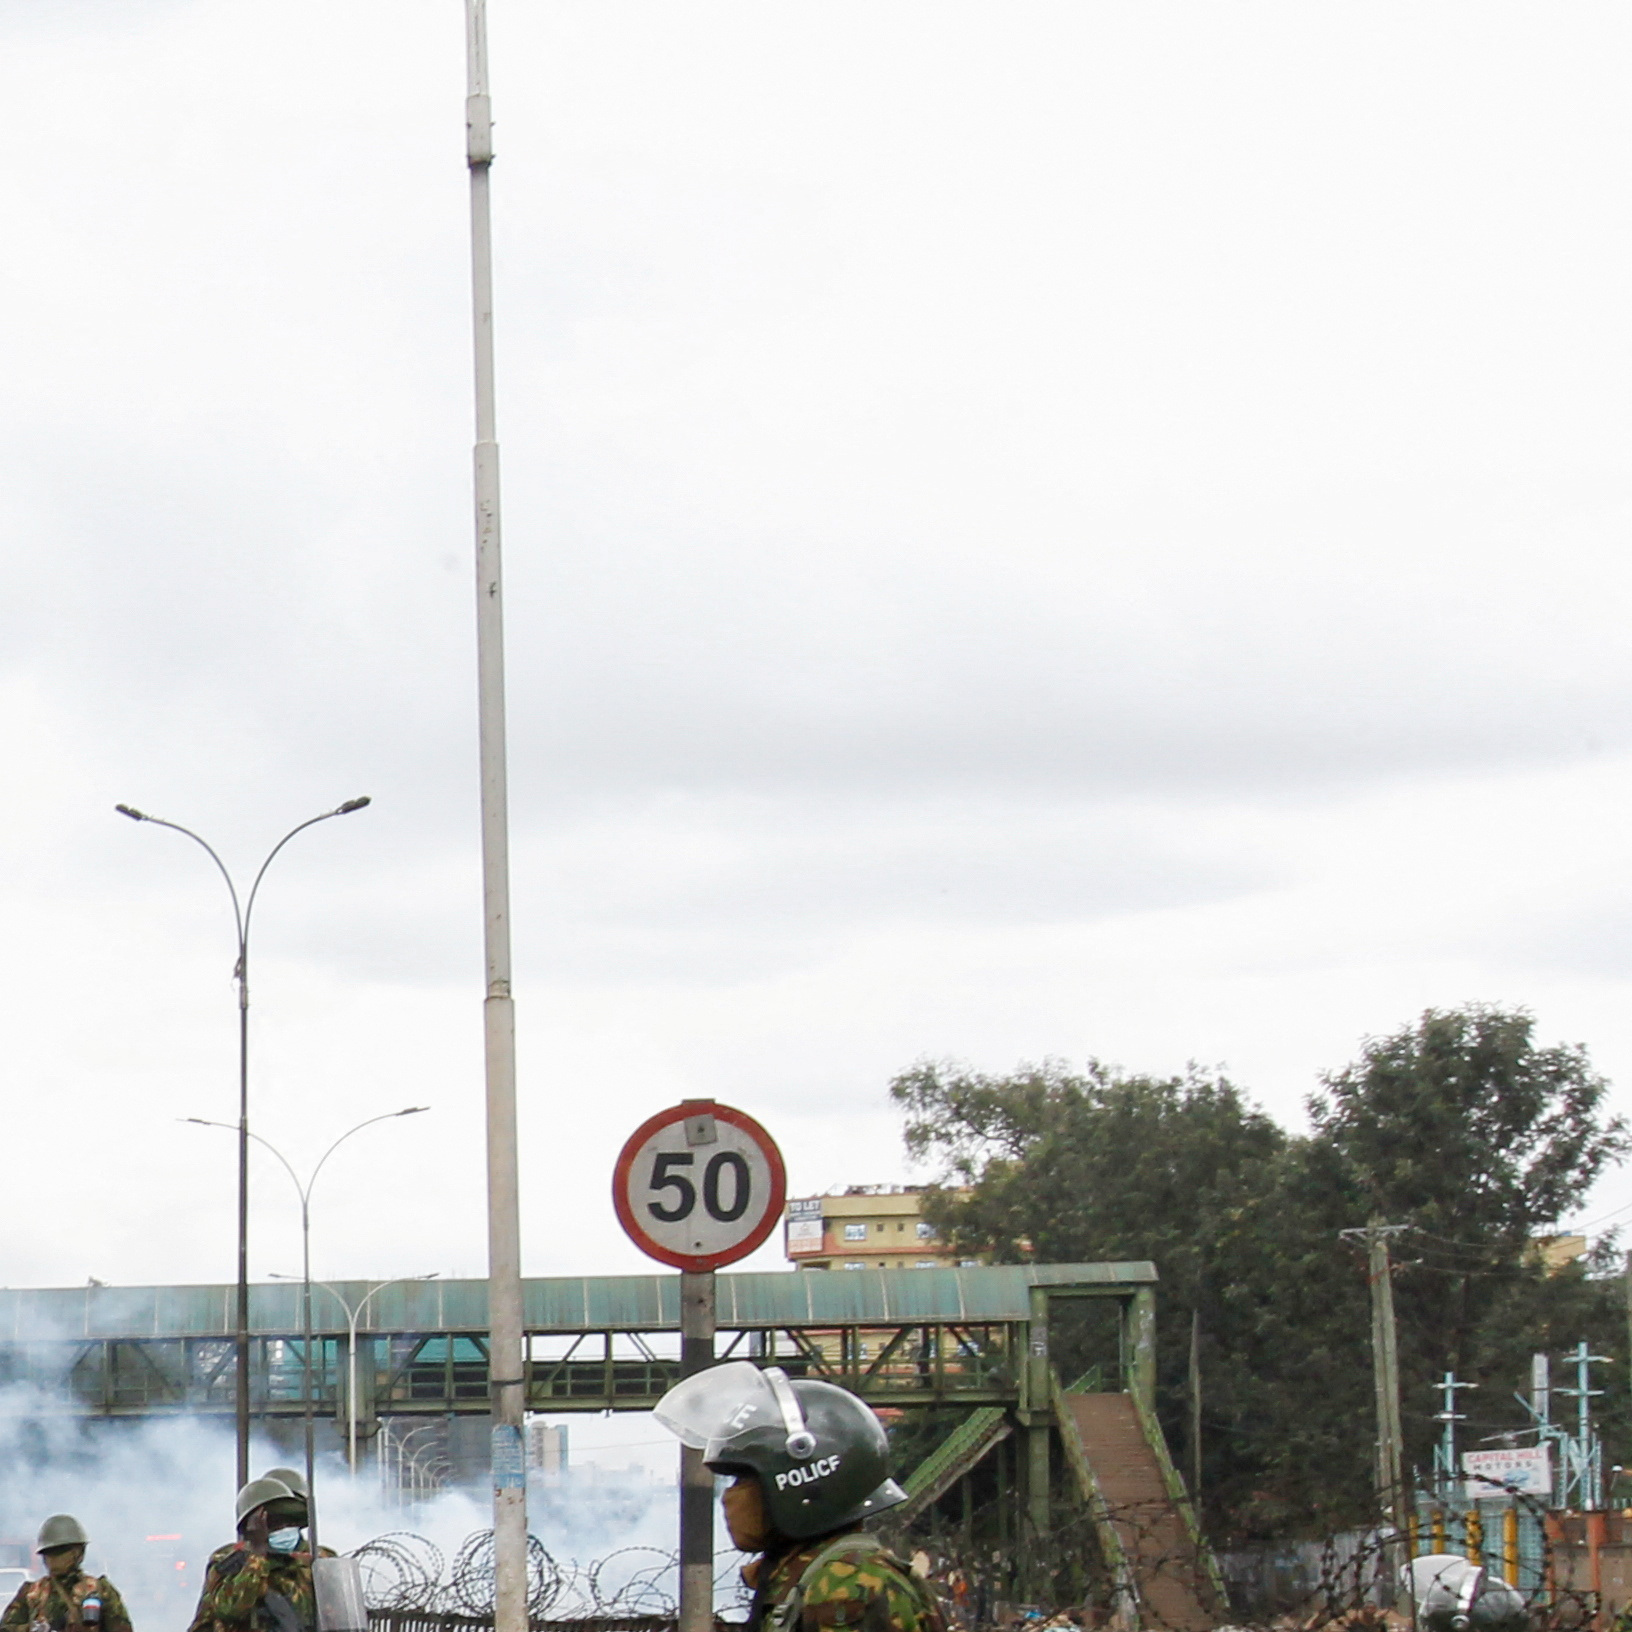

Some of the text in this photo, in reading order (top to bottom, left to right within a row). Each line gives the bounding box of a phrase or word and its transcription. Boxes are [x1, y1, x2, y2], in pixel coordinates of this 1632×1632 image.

[647, 1151, 750, 1223] 50
[1468, 1453, 1513, 1463] CAPITAL
[1473, 1460, 1532, 1471] MOTORS
